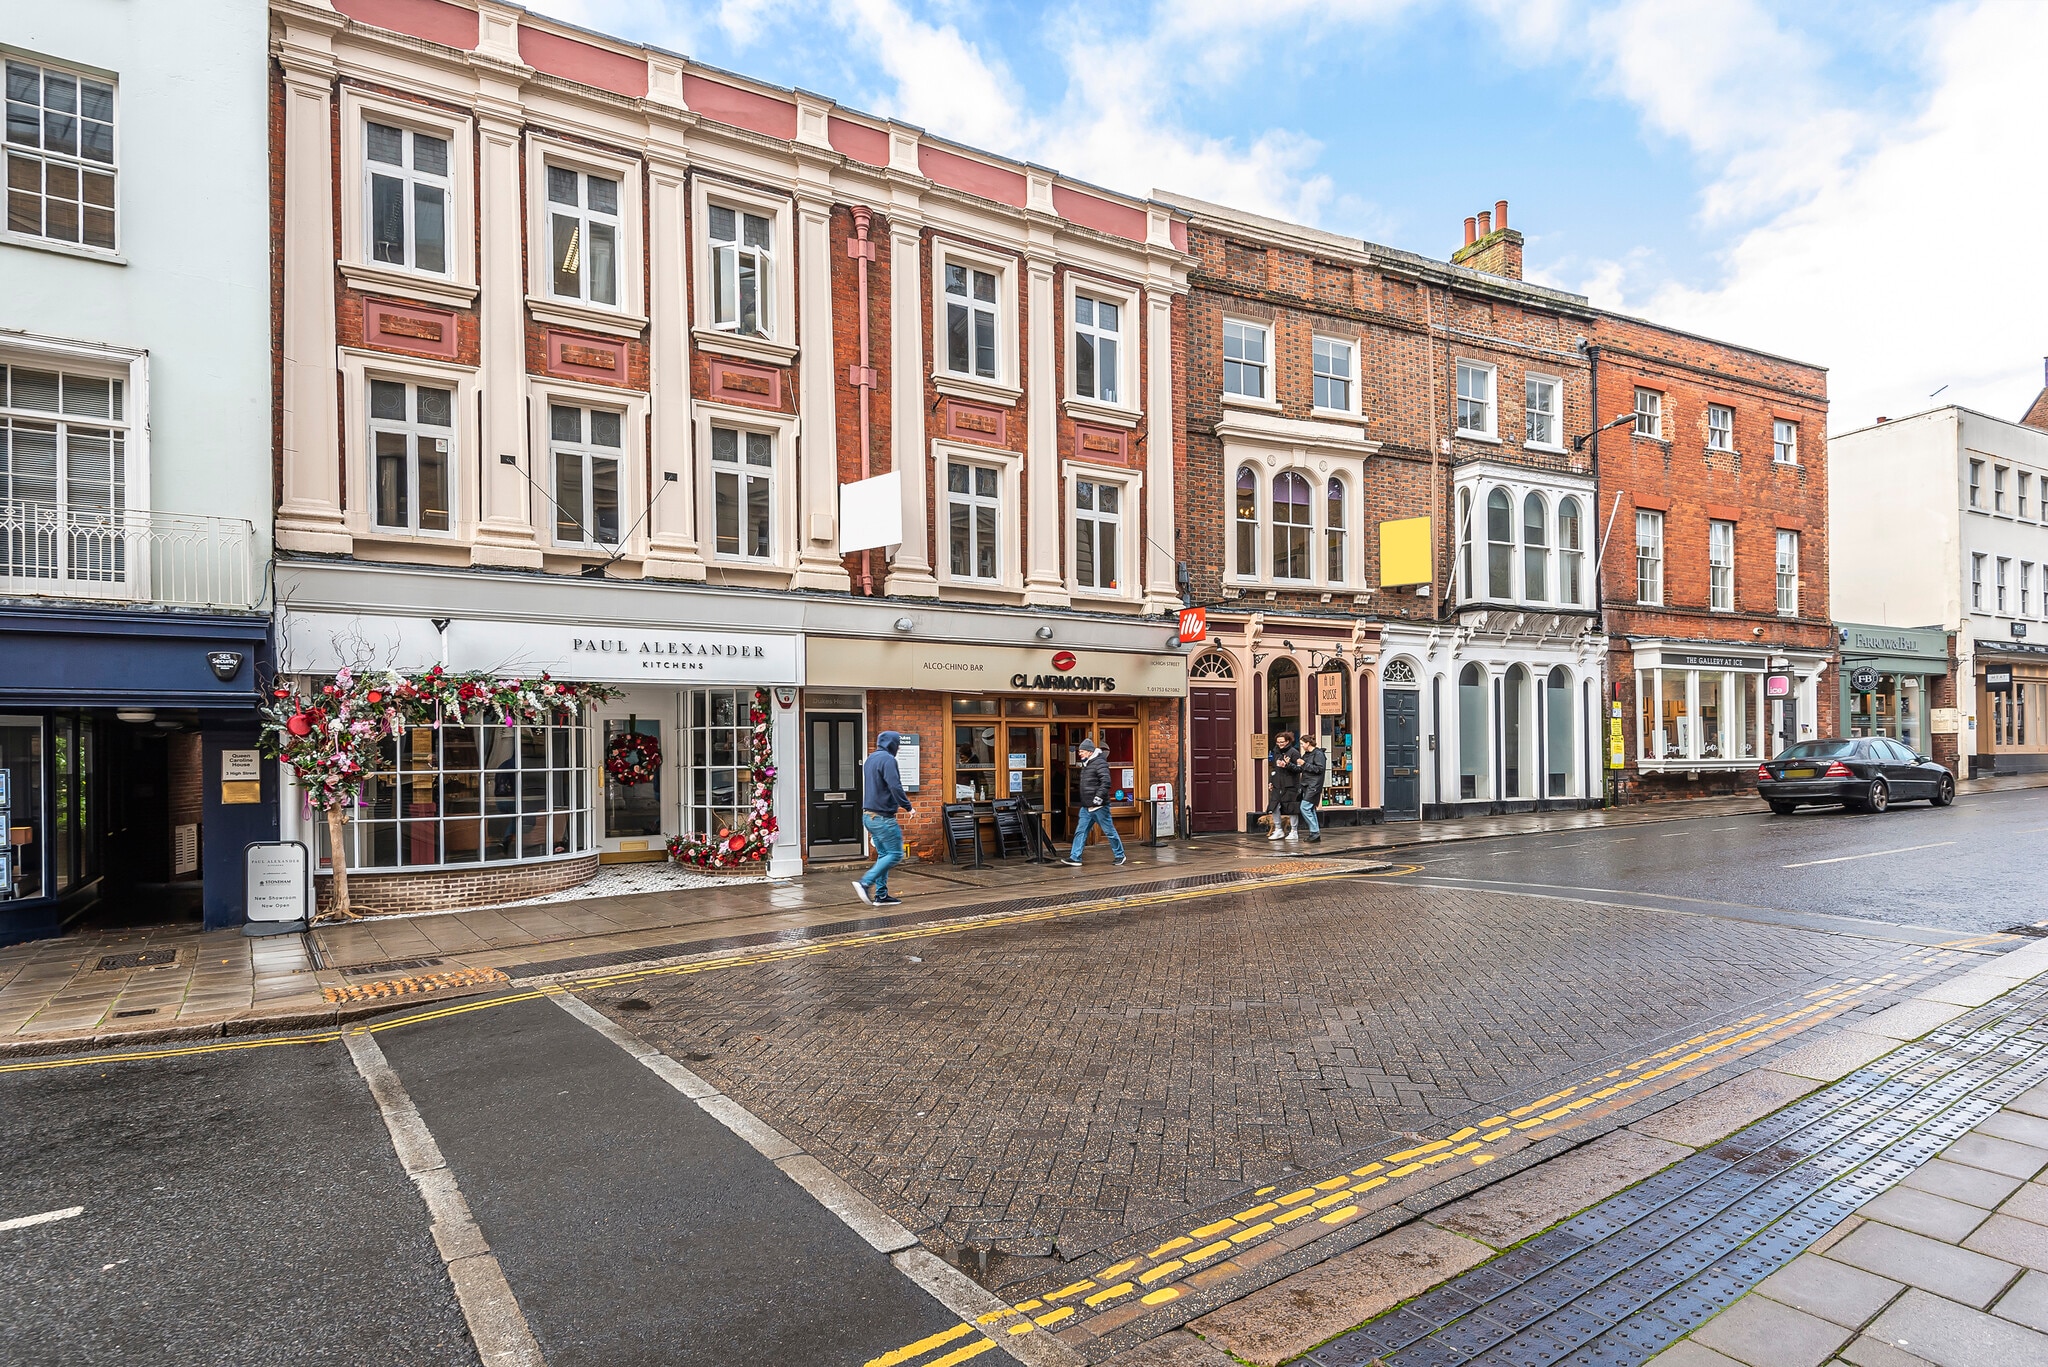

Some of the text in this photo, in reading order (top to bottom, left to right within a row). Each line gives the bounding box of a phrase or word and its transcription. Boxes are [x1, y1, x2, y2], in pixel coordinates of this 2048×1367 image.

[1180, 613, 1204, 639] illy
[573, 638, 764, 658] PAUL ALEXANDER
[642, 661, 704, 670] KITCHENS
[923, 662, 968, 671] ALCO-CHINO
[1011, 674, 1116, 692] CLAIRMONT'S
[1322, 689, 1337, 700] RUSSE
